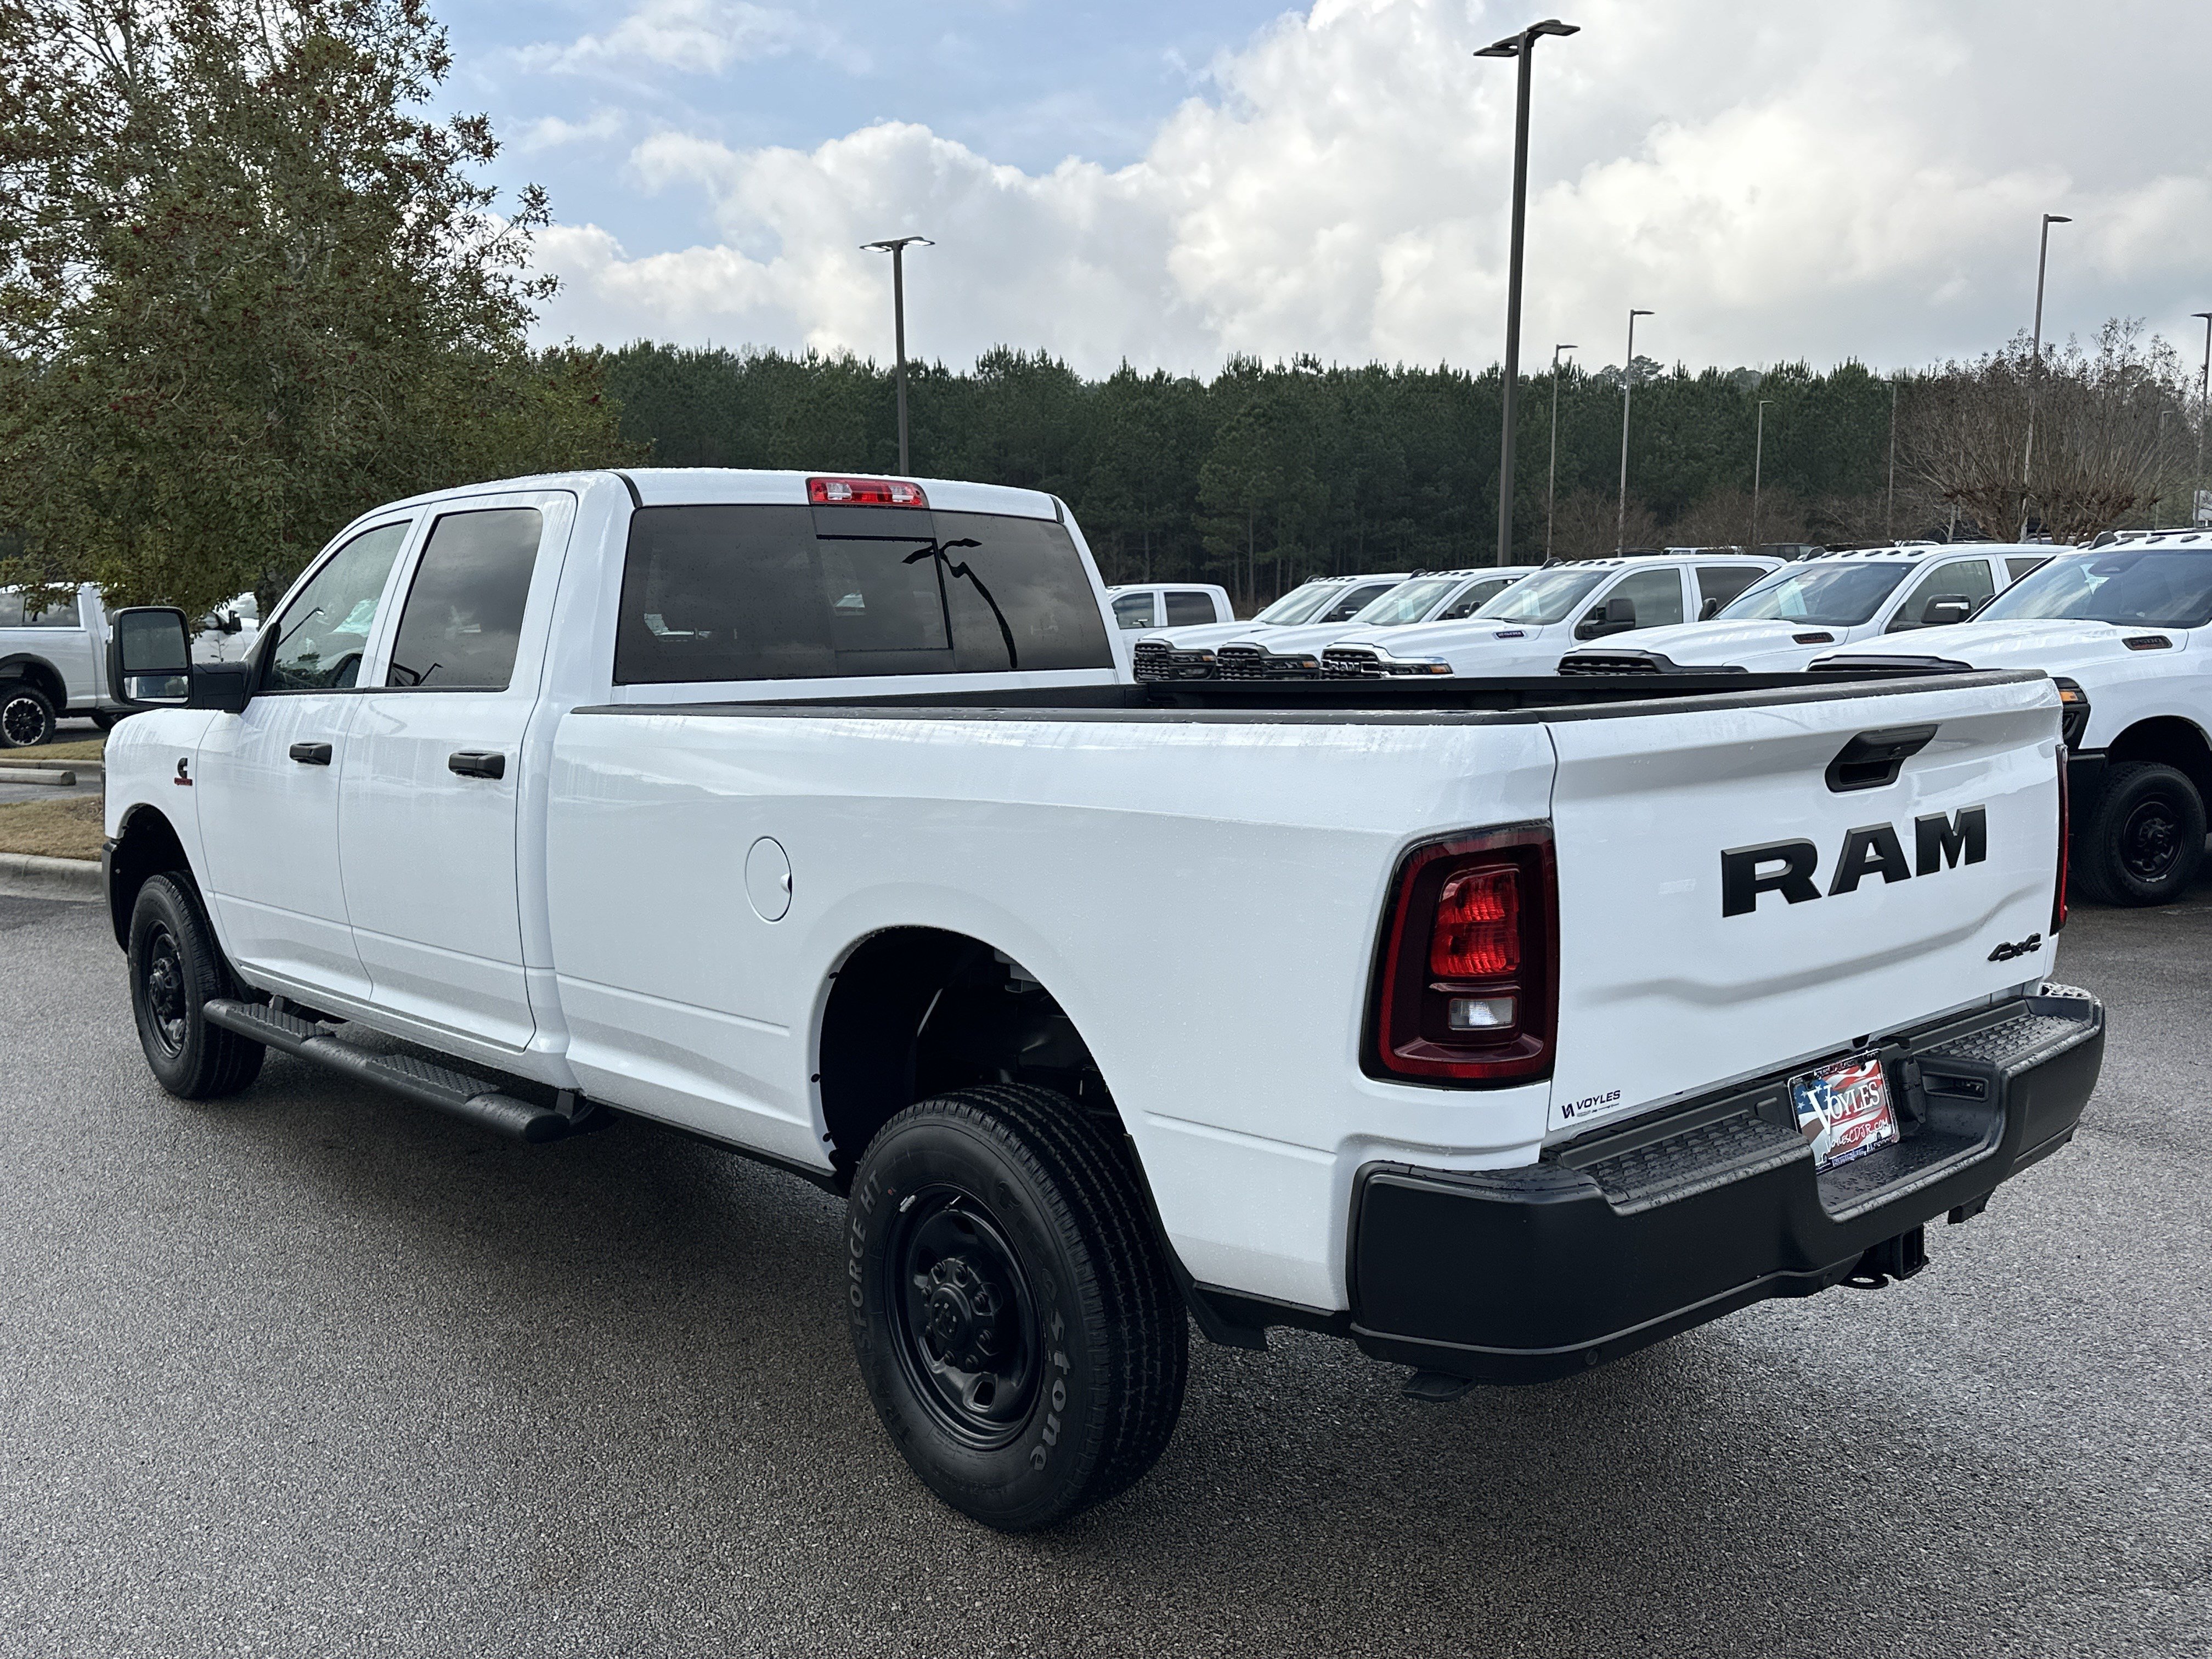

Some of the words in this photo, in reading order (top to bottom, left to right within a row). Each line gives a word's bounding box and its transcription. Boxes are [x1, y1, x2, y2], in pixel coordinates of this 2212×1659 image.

[1720, 804, 1987, 918] RAM
[1576, 1090, 1621, 1110] VOYLES
[1807, 1081, 1881, 1135] VOYLES
